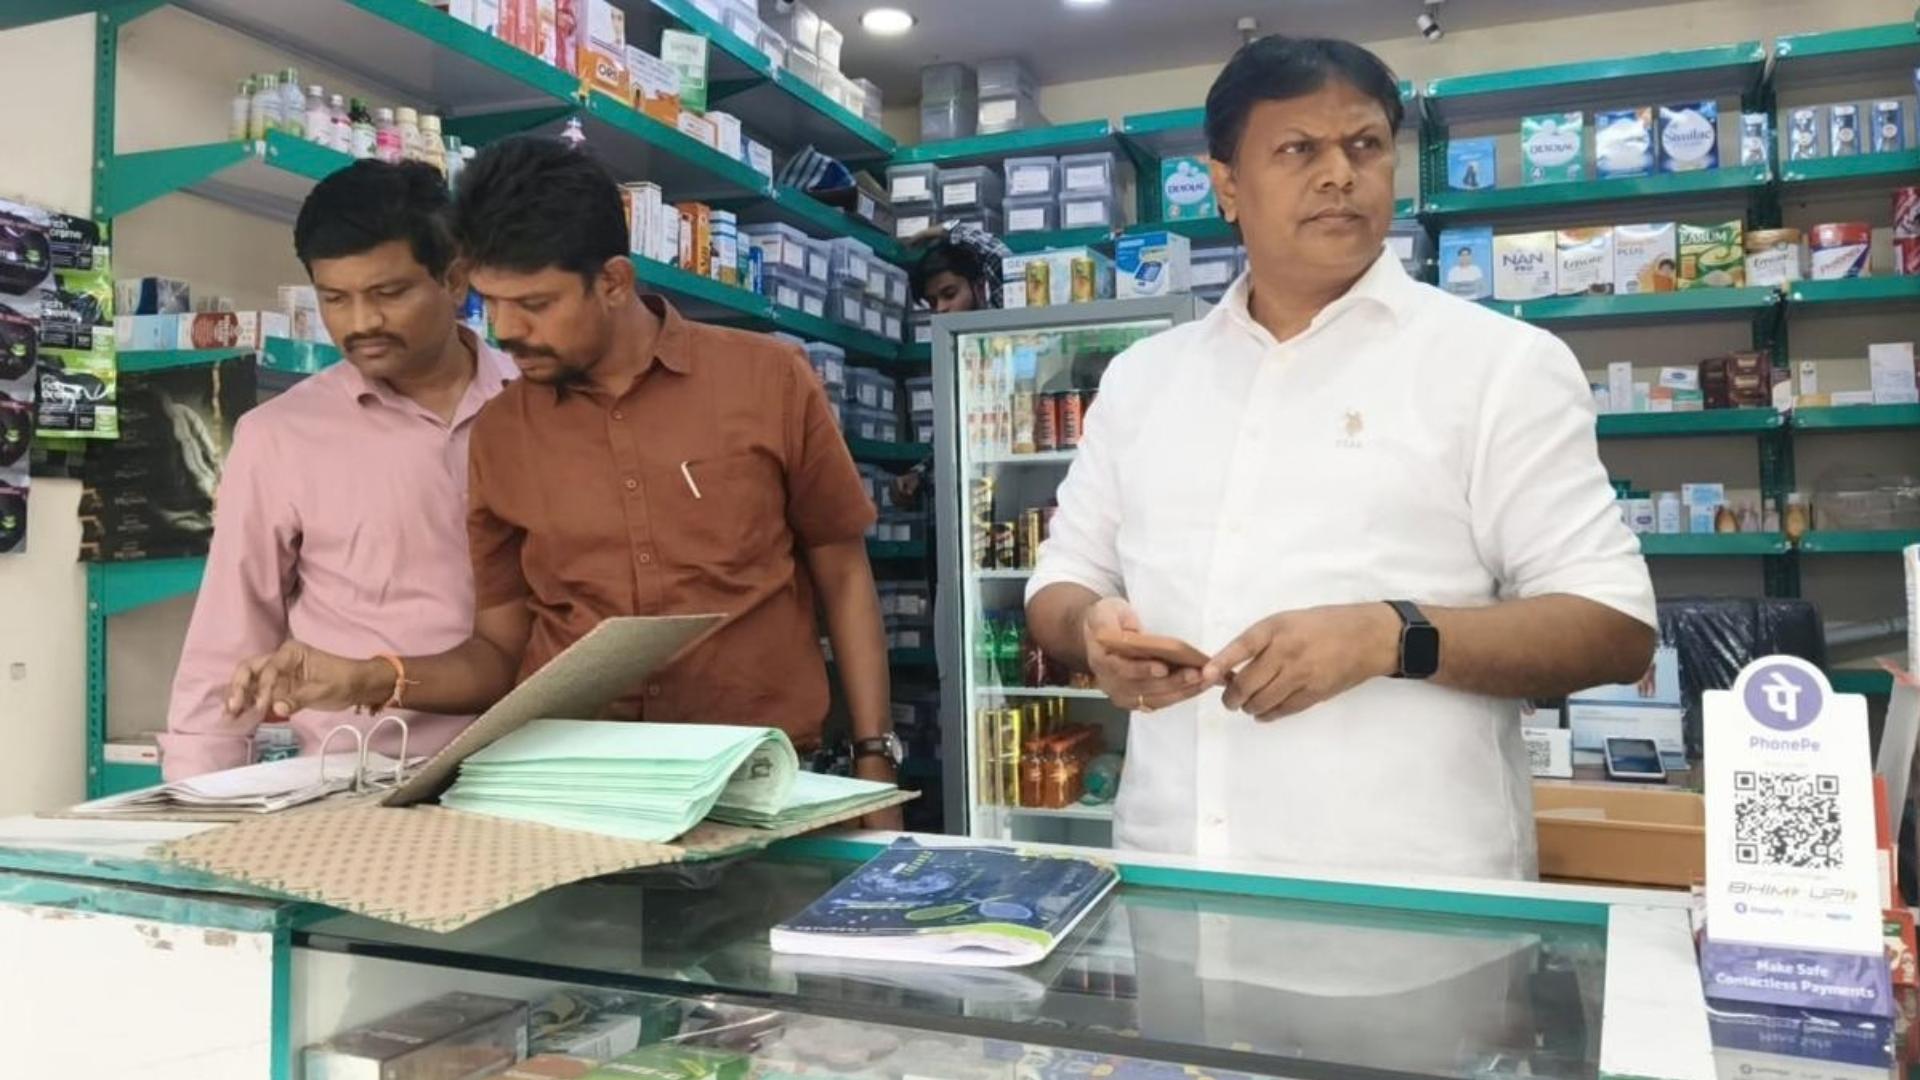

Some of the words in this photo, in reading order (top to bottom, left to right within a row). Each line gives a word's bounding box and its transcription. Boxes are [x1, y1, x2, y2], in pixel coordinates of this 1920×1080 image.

[1665, 128, 1712, 142] Similac
[1502, 252, 1544, 267] NAN
[1762, 672, 1802, 722] पे
[1749, 735, 1820, 752] PhonePe
[1756, 960, 1794, 974] Make
[1797, 963, 1829, 977] Safe
[1715, 972, 1798, 991] Contactless
[1801, 980, 1876, 999] Payments
